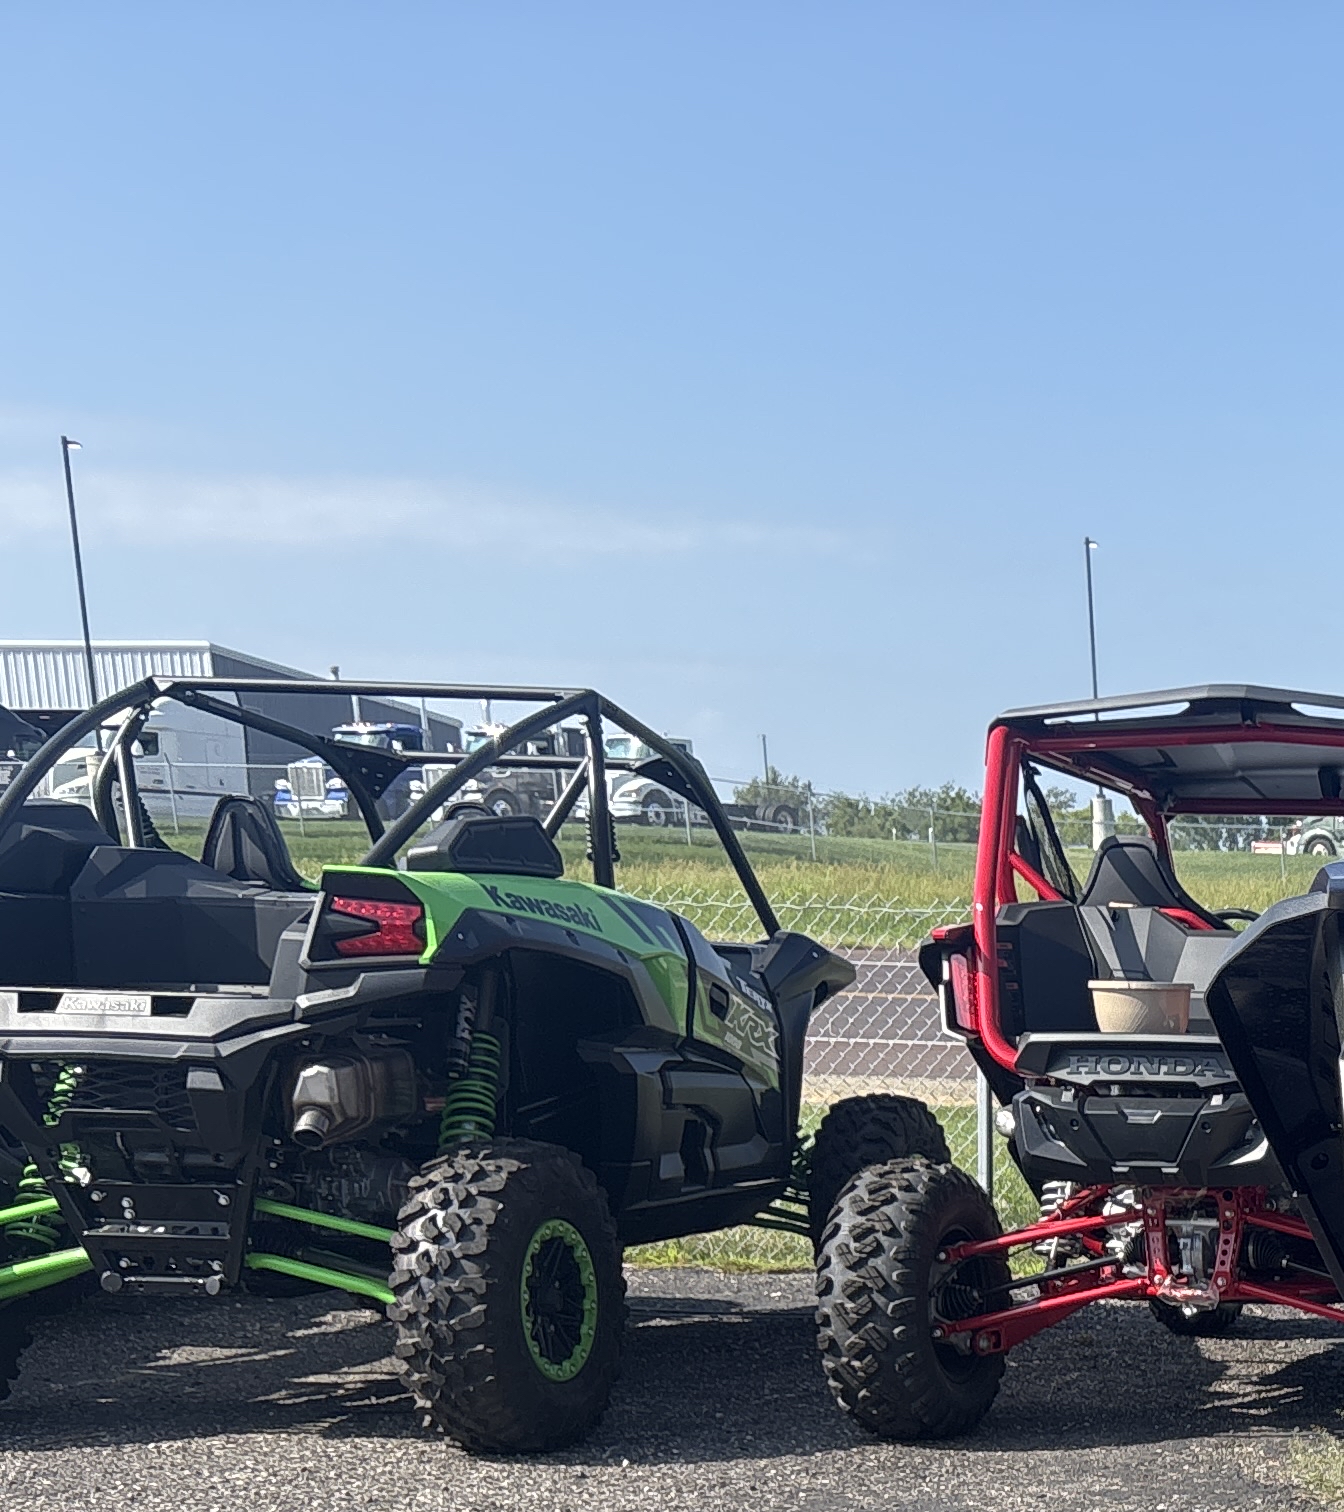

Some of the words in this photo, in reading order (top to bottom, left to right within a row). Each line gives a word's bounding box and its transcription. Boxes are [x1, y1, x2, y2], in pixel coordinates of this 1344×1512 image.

[480, 883, 603, 933] Kawasaki
[62, 997, 147, 1013] Kawasaki
[1066, 1055, 1231, 1079] HONDA
